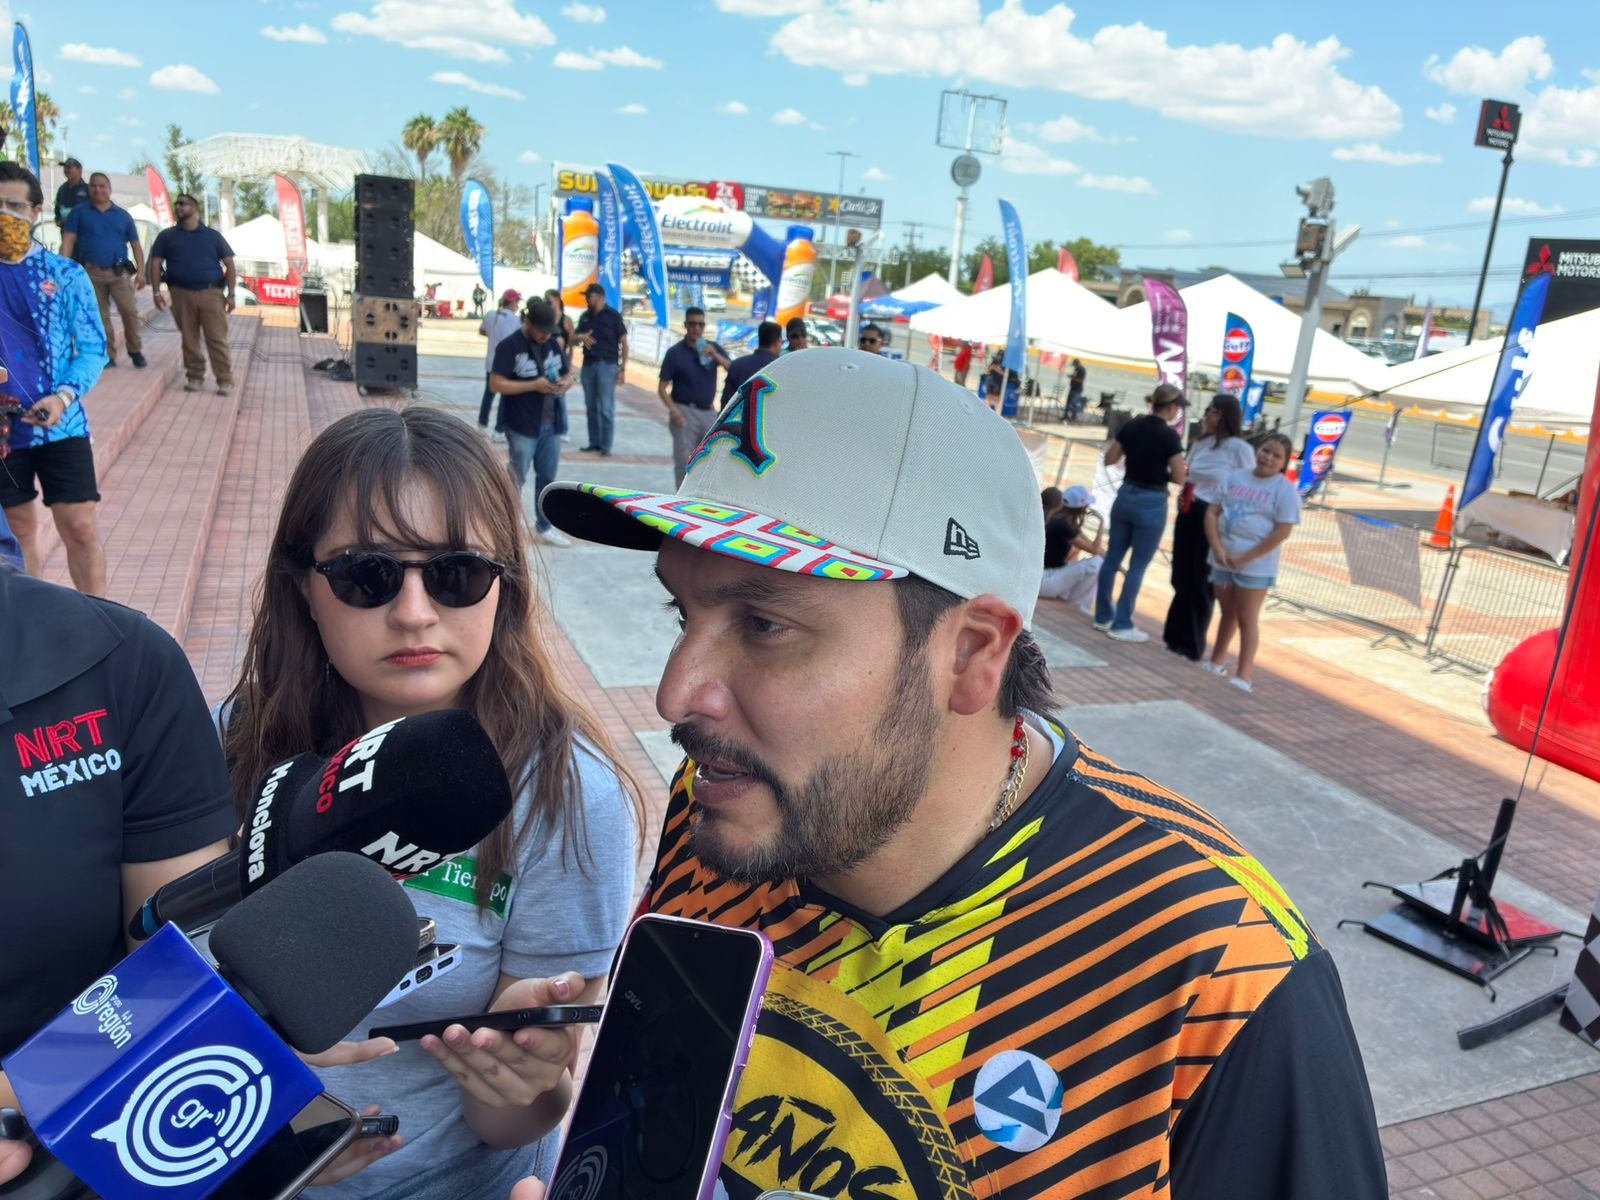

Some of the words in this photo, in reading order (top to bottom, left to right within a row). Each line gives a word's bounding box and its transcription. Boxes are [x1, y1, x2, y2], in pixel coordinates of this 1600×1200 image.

[661, 214, 734, 235] Electrolit
[263, 284, 298, 299] TECAT
[684, 374, 779, 478] A
[14, 708, 108, 769] NRT
[20, 748, 122, 797] MÉXICO
[247, 761, 294, 883] Monclova
[441, 861, 507, 902] Tiepo
[95, 1001, 132, 1049] región
[170, 1098, 215, 1129] gr
